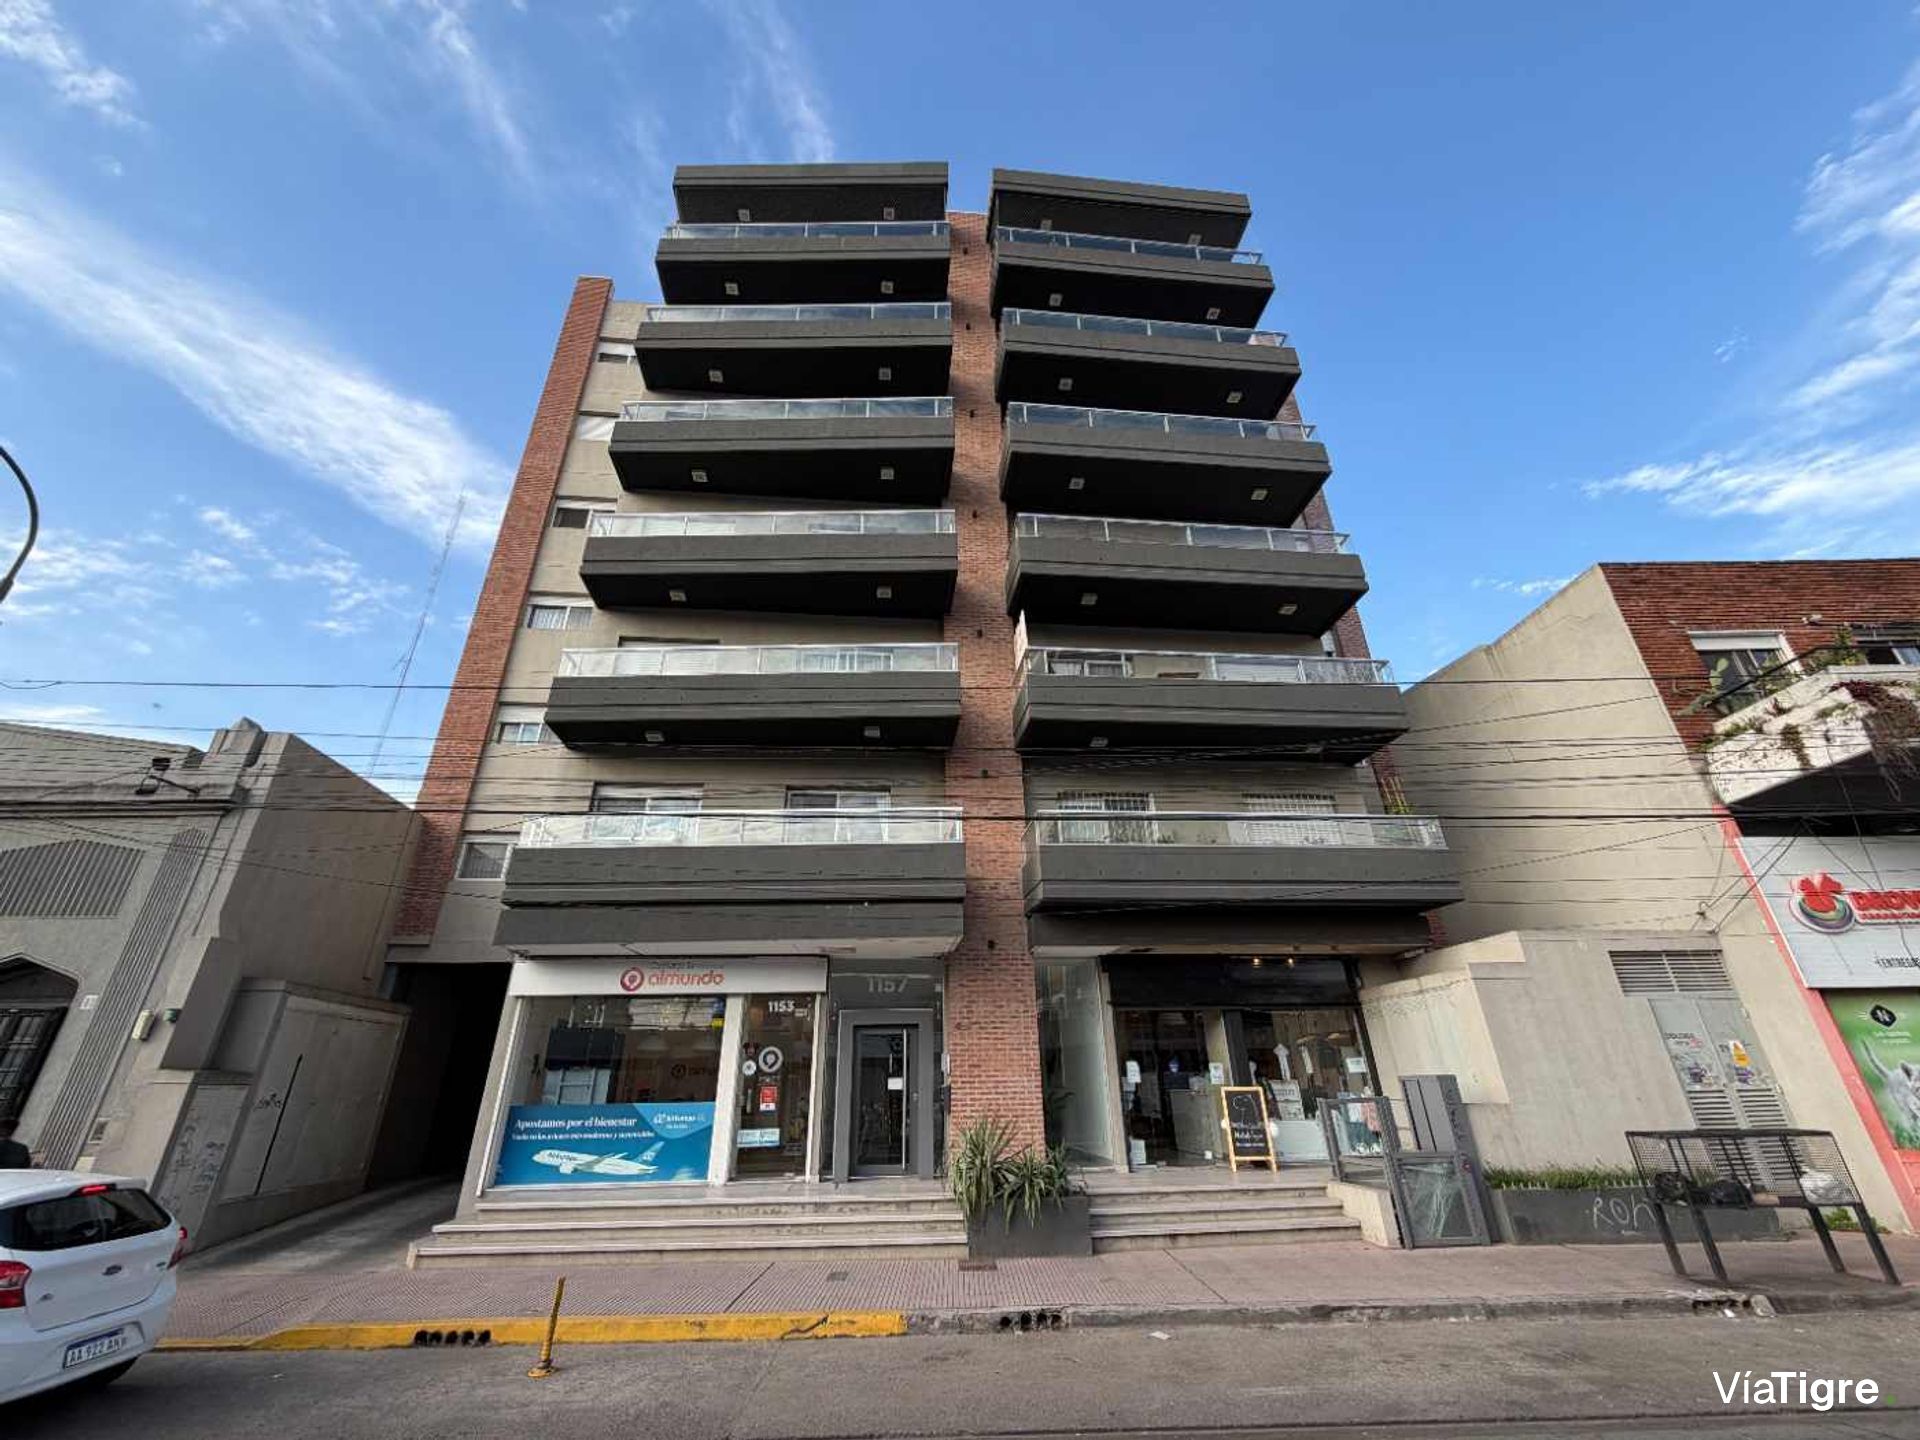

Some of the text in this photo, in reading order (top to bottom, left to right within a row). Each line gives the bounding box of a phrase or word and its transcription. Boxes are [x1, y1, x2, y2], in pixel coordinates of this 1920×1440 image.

[648, 969, 725, 987] almundo
[866, 977, 908, 993] 1157
[768, 1001, 795, 1013] 1153
[515, 1116, 638, 1132] Apostamos por el bienestar
